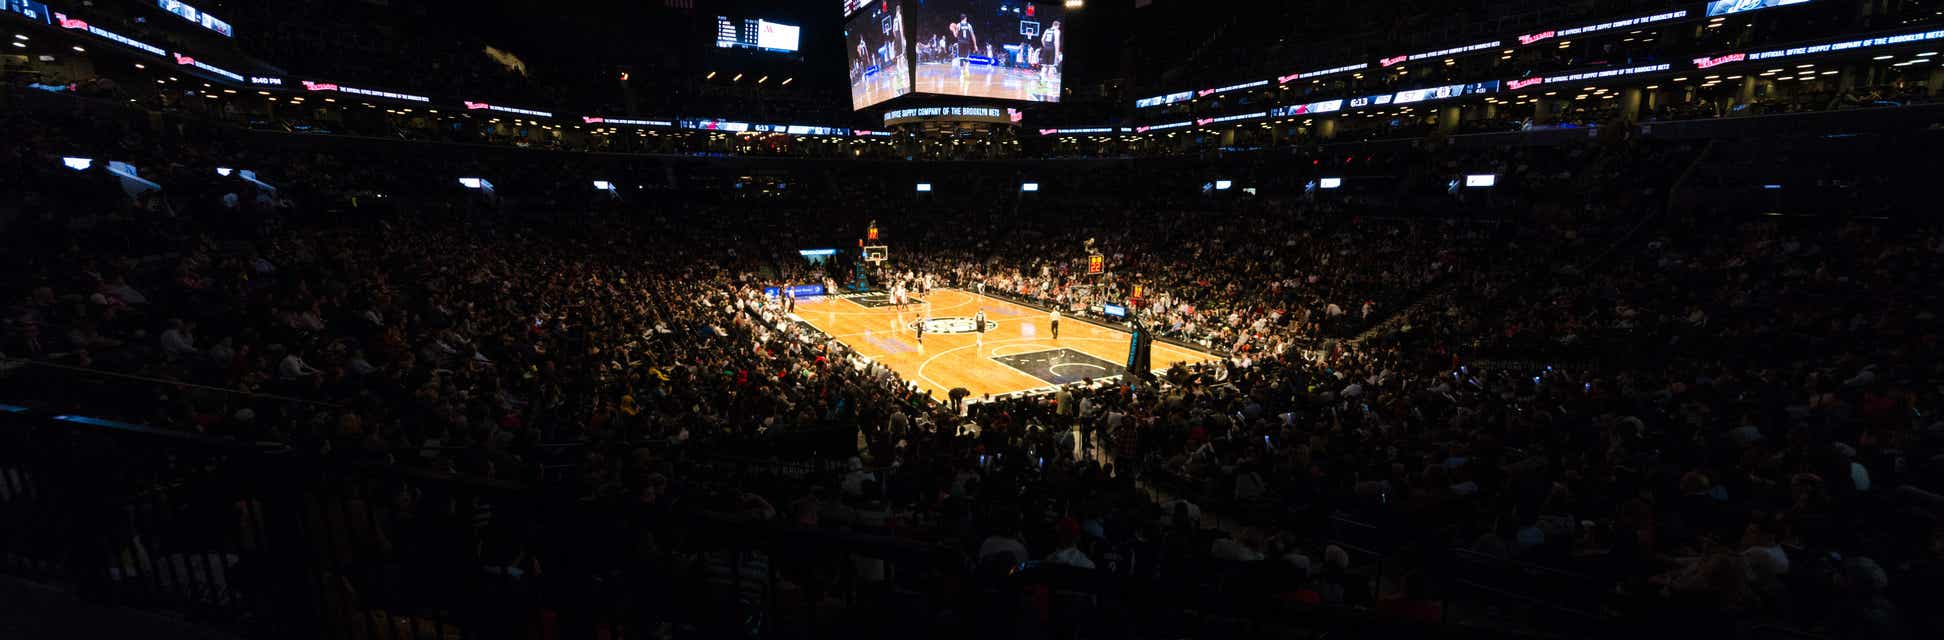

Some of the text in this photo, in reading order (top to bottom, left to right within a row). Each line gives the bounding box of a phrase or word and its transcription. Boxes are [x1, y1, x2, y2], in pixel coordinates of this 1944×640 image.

[1760, 50, 1784, 58] OFFICIAL
[1832, 41, 1862, 50] COMPANY
[1888, 33, 1924, 43] BROOKLYN
[1350, 98, 1368, 107] 6:13
[902, 108, 917, 117] SUPPLY
[918, 108, 941, 116] COMPANY
[989, 108, 1000, 116] NETS
